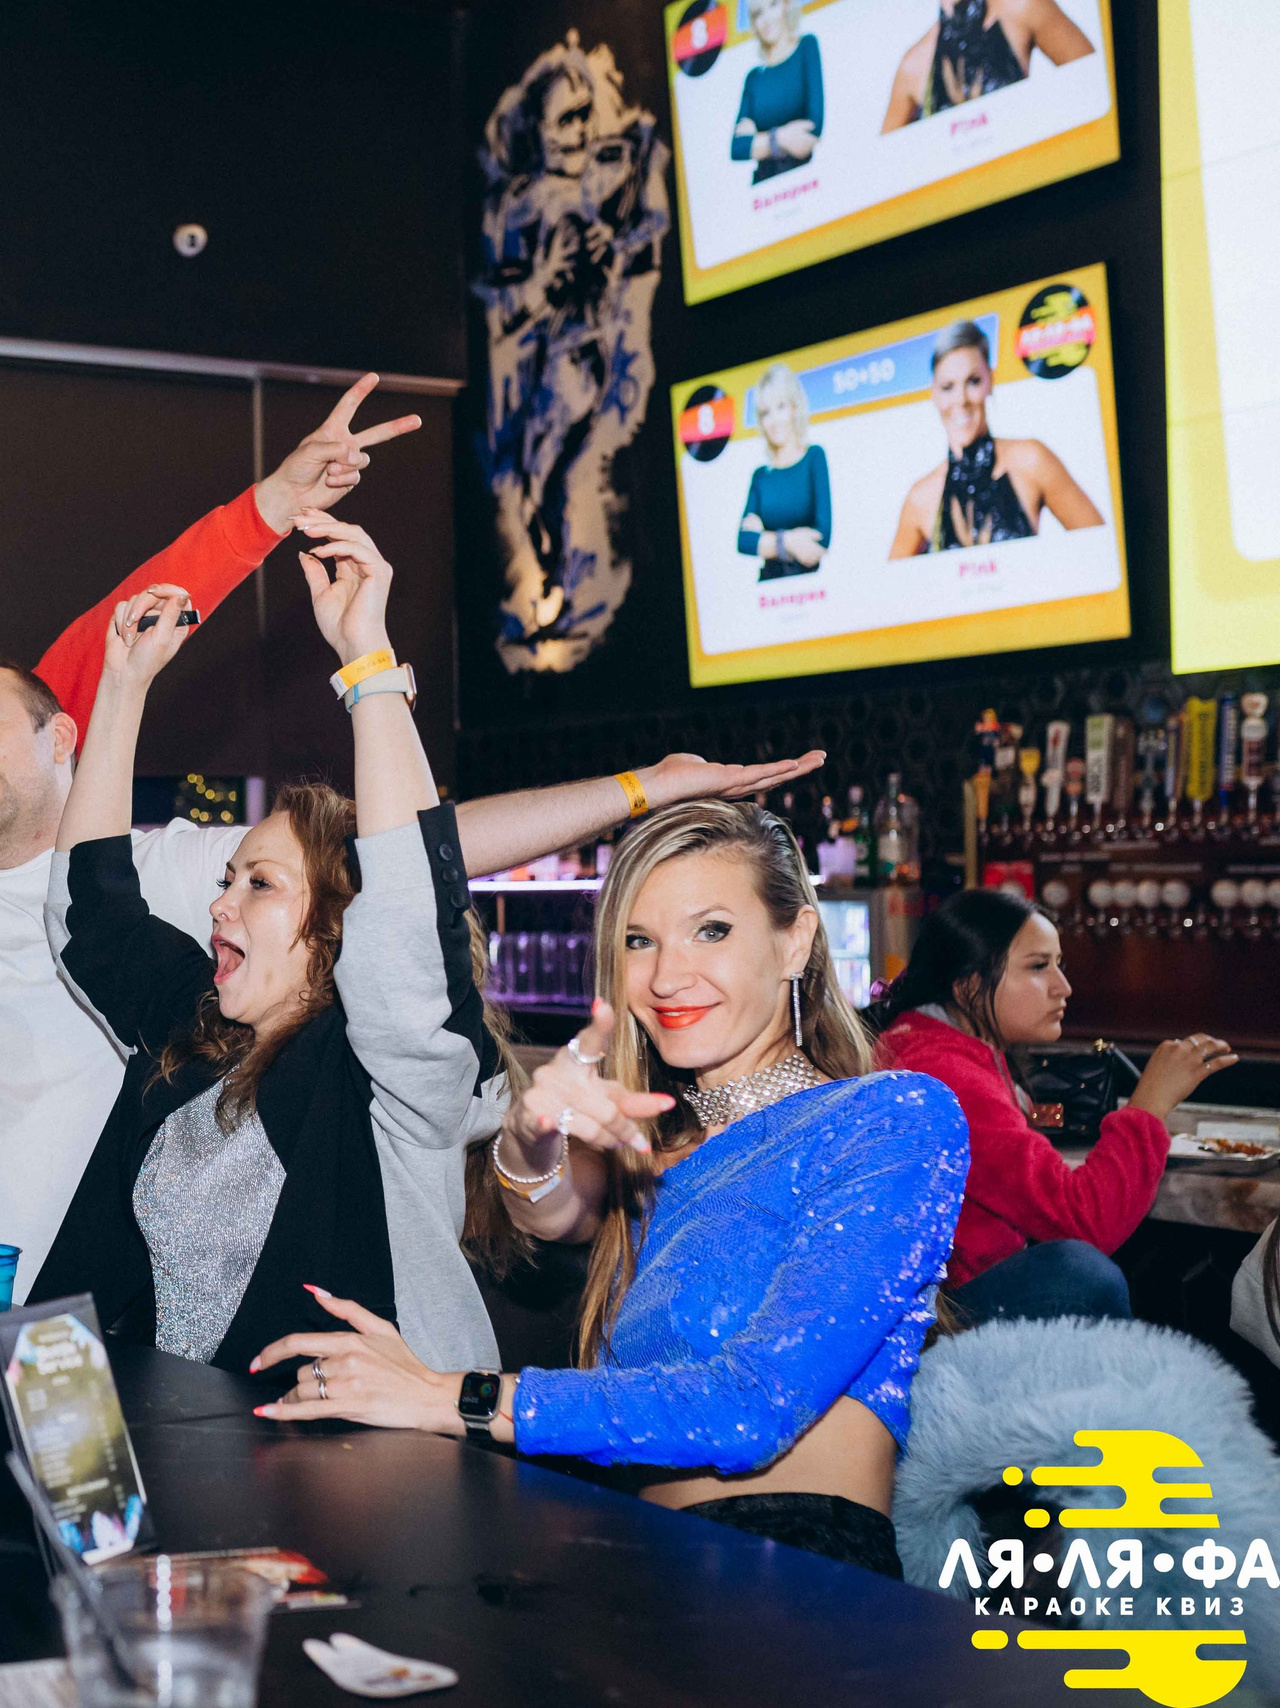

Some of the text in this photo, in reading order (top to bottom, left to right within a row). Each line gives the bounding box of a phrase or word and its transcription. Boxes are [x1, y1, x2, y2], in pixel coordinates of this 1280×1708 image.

[690, 18, 708, 50] 8
[832, 358, 896, 394] 50+50
[698, 405, 715, 435] 8
